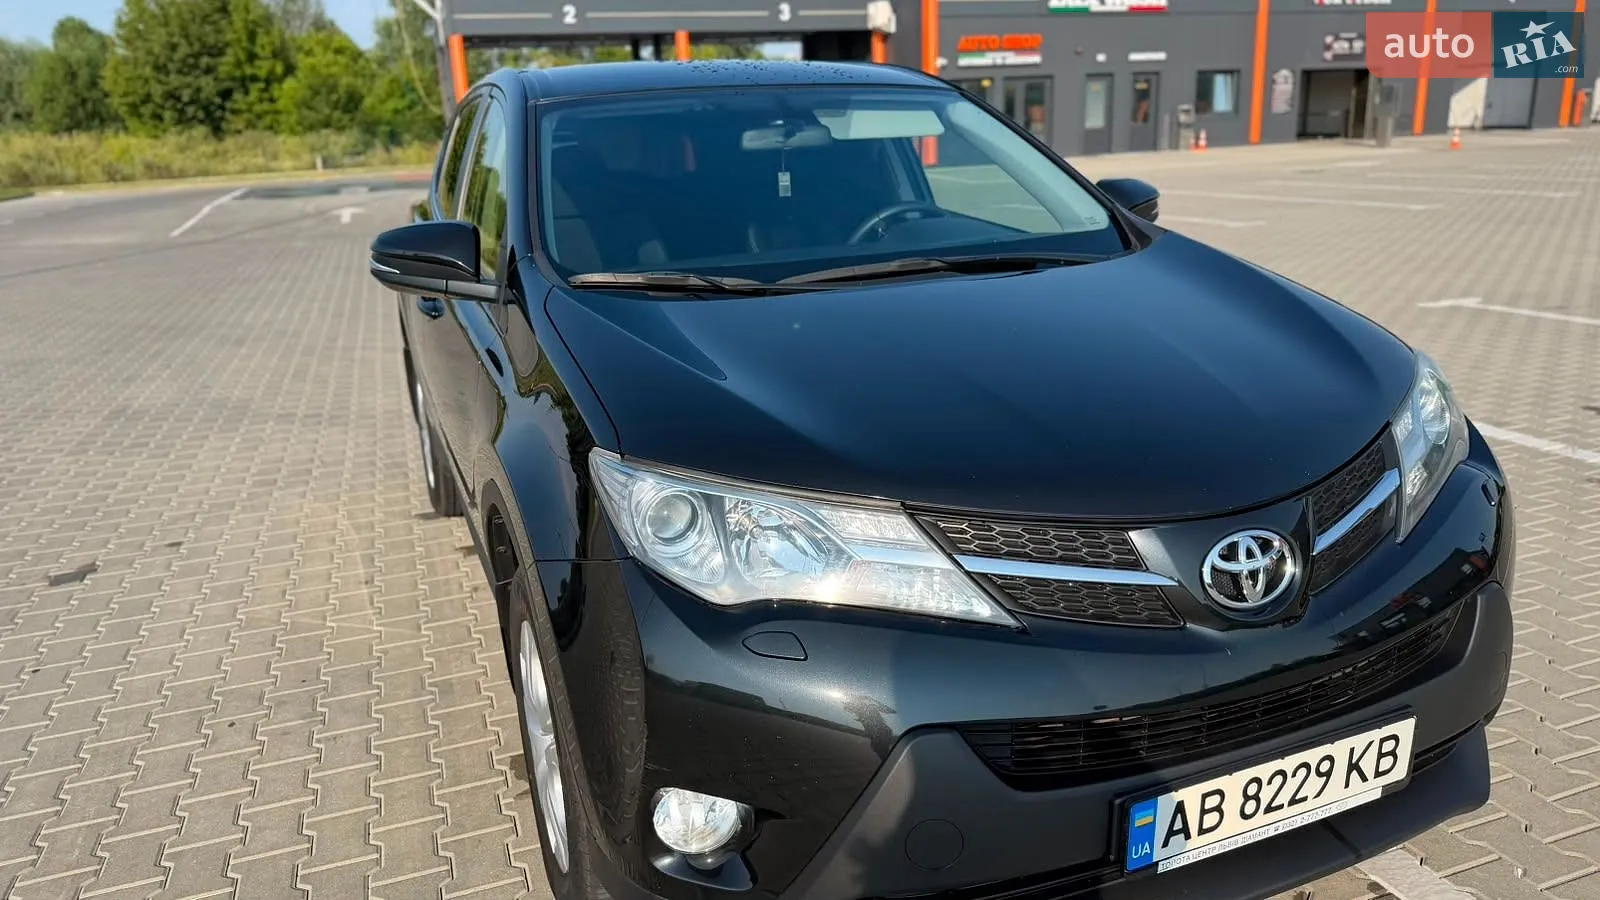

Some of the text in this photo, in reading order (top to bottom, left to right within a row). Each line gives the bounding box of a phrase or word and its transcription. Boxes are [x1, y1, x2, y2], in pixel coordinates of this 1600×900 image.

[562, 4, 577, 24] 2
[778, 2, 791, 22] 3
[1161, 733, 1401, 849] AB 8229 KB
[1131, 842, 1151, 859] UA
